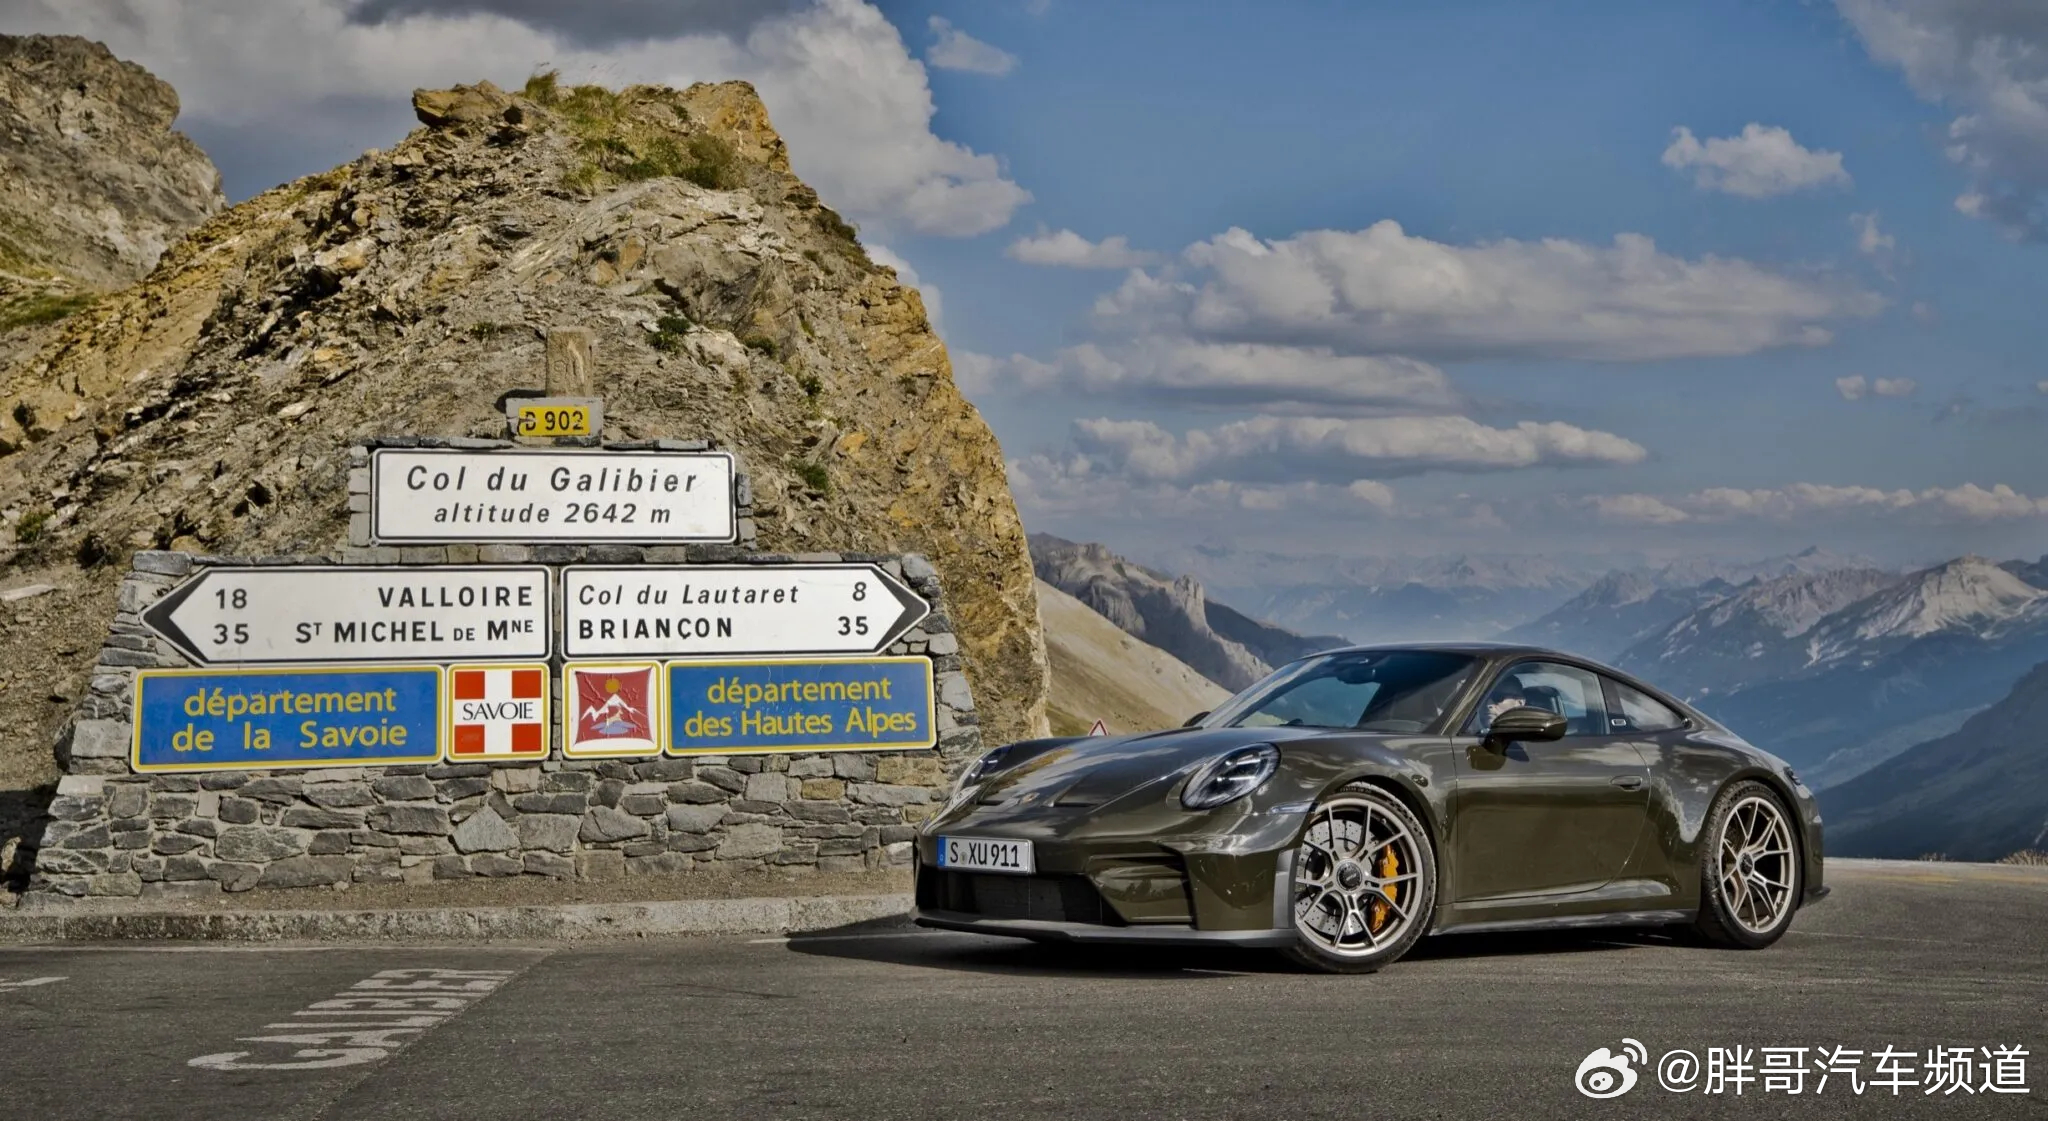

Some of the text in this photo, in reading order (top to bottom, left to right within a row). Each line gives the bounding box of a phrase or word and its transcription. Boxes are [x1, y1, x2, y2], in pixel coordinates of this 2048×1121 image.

[544, 411, 584, 431] 902
[407, 465, 697, 493] Col du Galibier
[434, 502, 670, 524] altitude 2642 m
[215, 586, 532, 610] 18 VALLOIRE
[579, 581, 867, 606] Col du Lautaret 8
[213, 623, 250, 645] 35
[334, 620, 444, 644] MICHEL
[453, 627, 475, 642] DE
[579, 616, 869, 640] BRIANÇON 35
[183, 687, 397, 721] département
[707, 677, 891, 709] département
[462, 701, 533, 721] SAVOIE
[684, 707, 917, 738] des Hautes Alpes
[172, 717, 409, 752] de la Savoie
[187, 968, 515, 1070] GALIBIER
